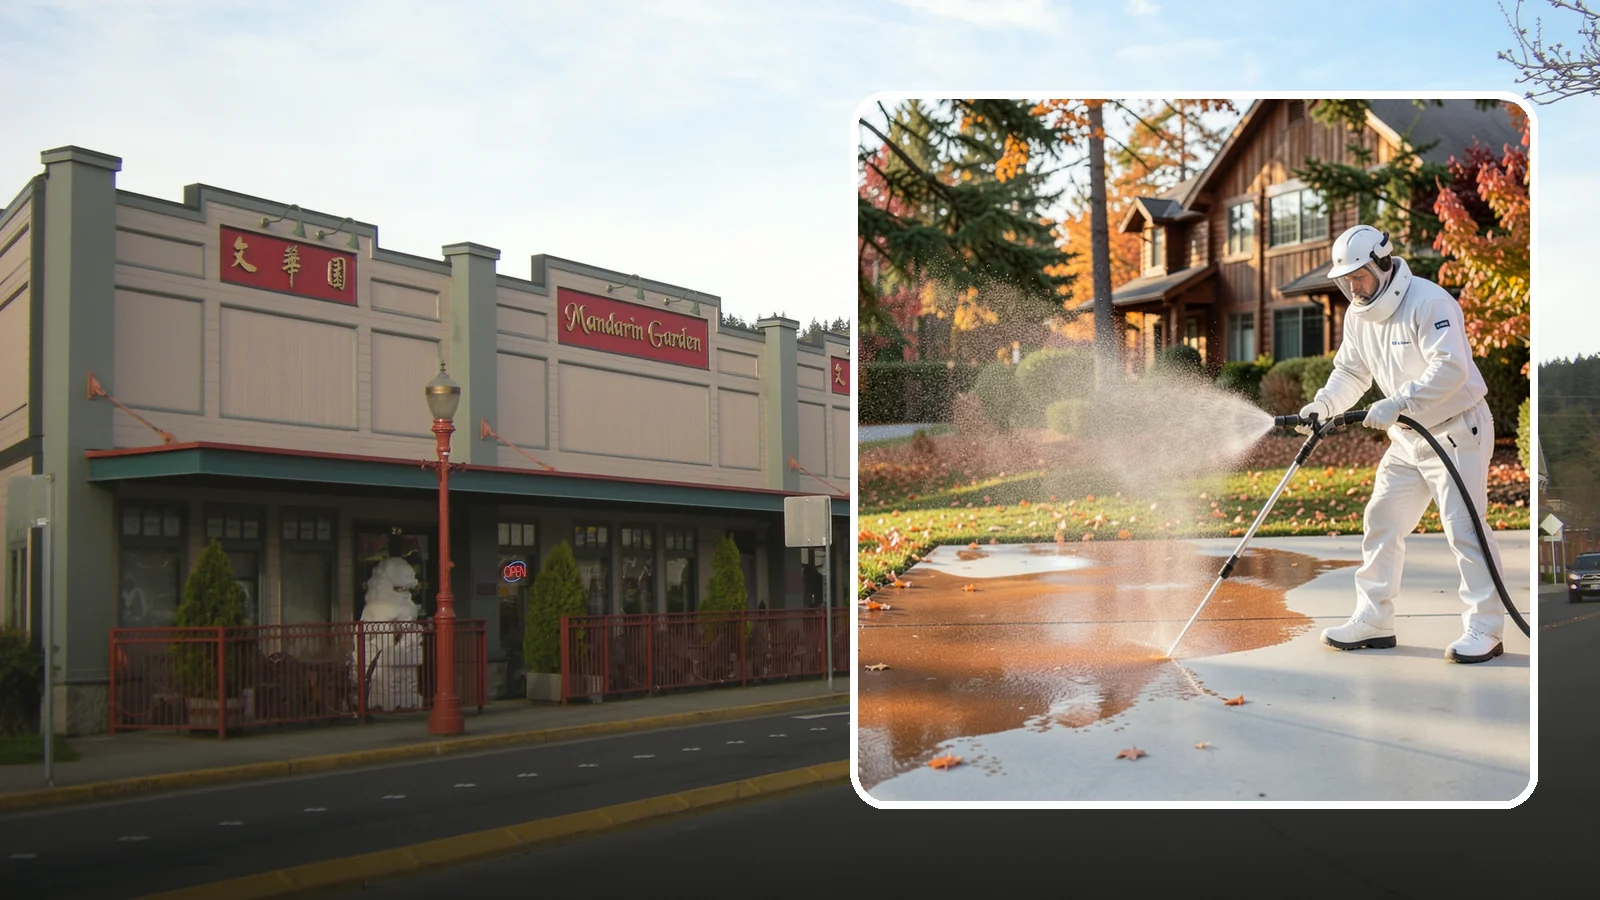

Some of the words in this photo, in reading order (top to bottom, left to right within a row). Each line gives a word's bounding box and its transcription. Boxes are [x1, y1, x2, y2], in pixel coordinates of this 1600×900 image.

[231, 235, 346, 291] 文華園
[564, 302, 644, 341] Mandarin
[648, 320, 701, 352] Garden
[503, 565, 527, 578] OPEN
